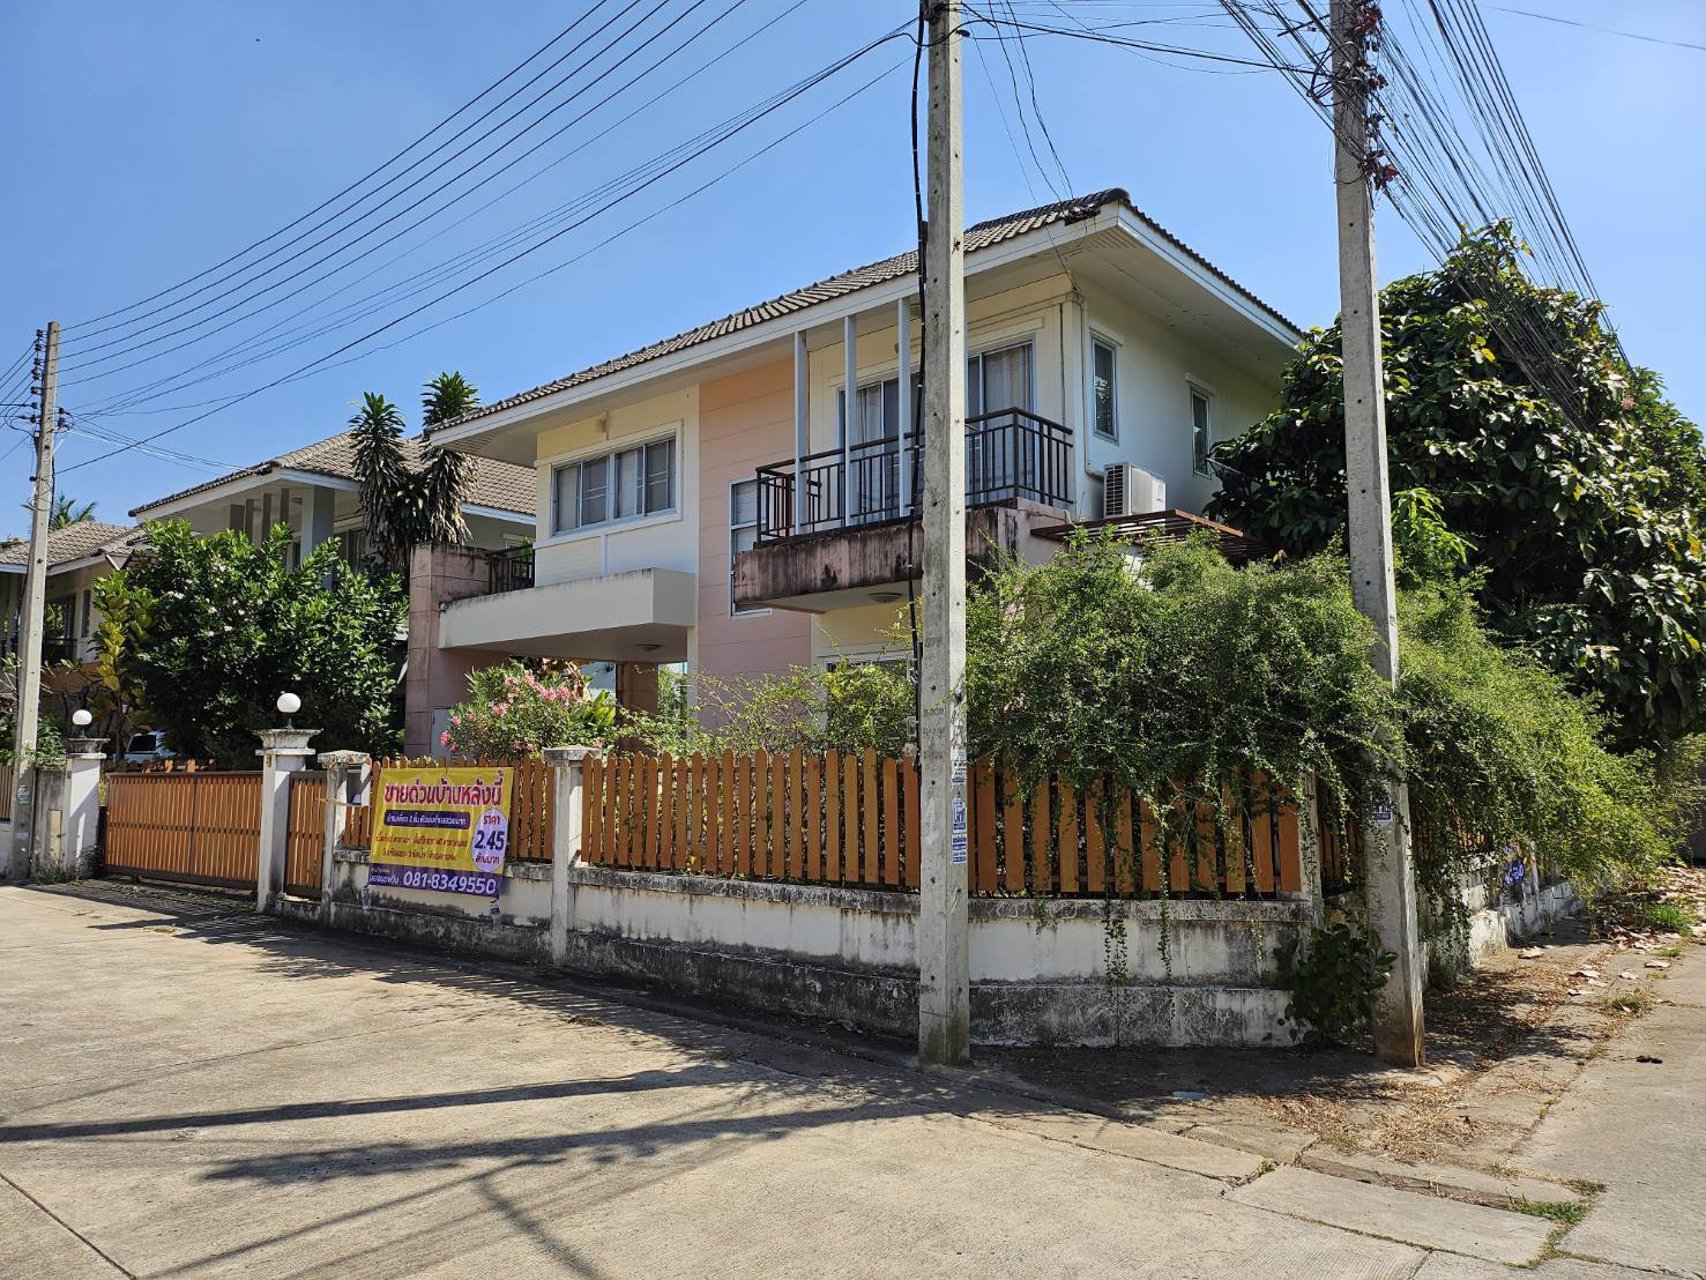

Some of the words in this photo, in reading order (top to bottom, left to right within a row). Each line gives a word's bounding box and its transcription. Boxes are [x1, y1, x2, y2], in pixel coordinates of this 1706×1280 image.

[384, 770, 504, 806] ขายด่วนบ้านหลังนี้
[483, 814, 500, 826] ราคา
[474, 830, 505, 850] 2.45
[475, 852, 500, 865] ล้านบาท
[403, 871, 497, 894] 081-8349550
